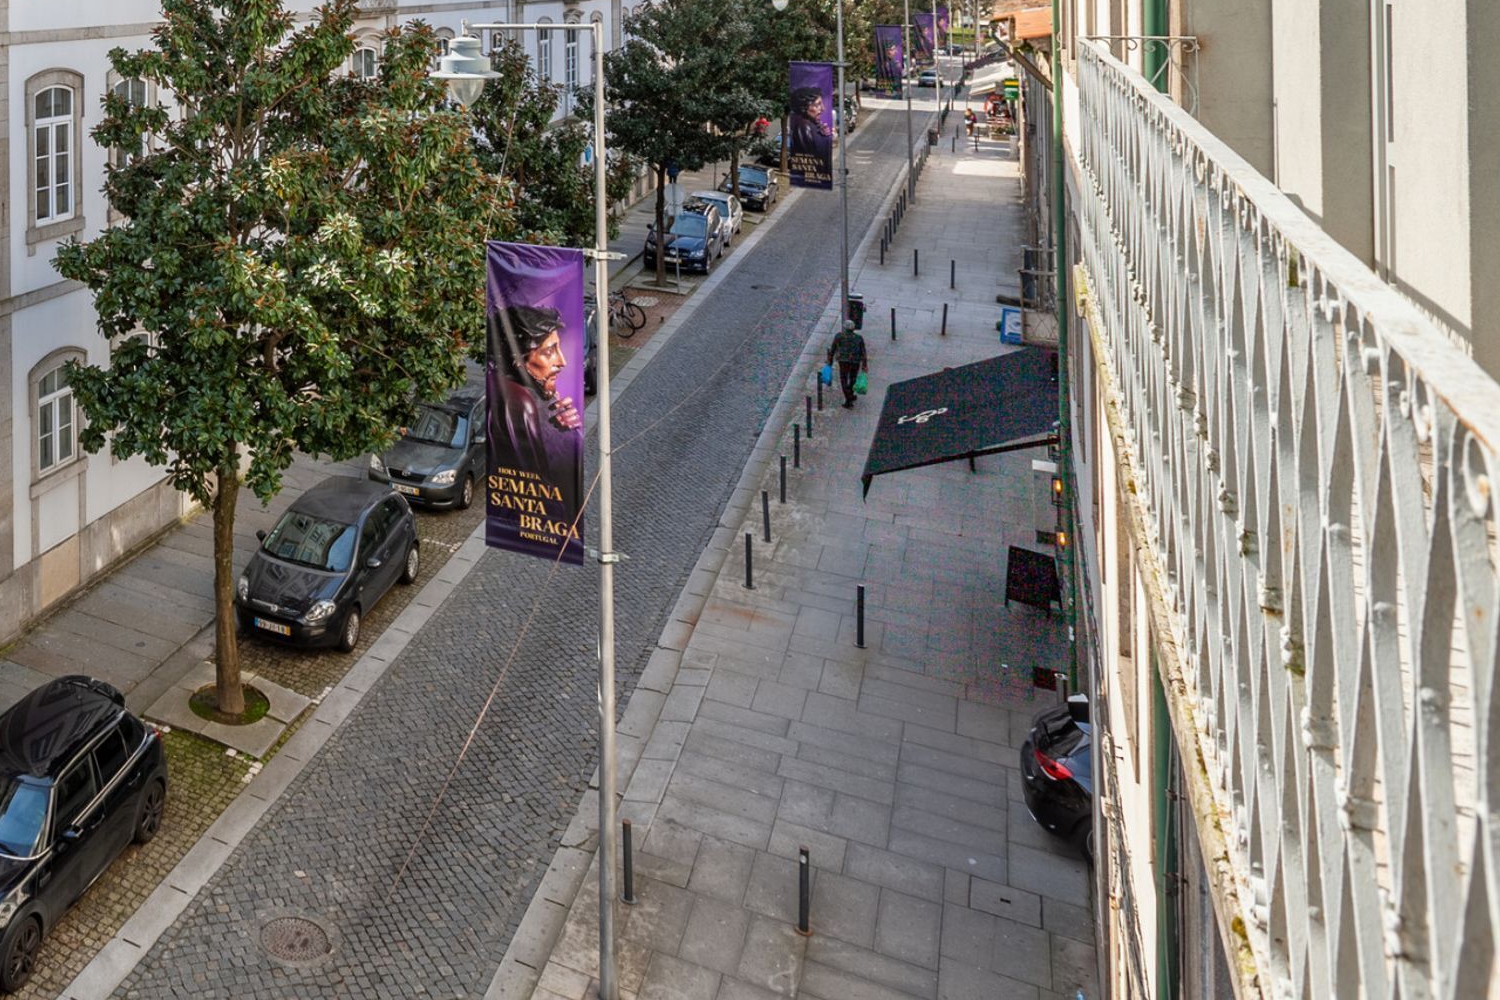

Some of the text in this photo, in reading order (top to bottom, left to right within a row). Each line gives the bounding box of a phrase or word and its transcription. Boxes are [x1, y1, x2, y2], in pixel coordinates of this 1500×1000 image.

[498, 467, 541, 481] HOLY WEEK
[488, 475, 563, 501] SEMANA
[491, 492, 547, 516] SANTA
[520, 514, 581, 539] BRAGA
[520, 531, 559, 545] PORTUGAL
